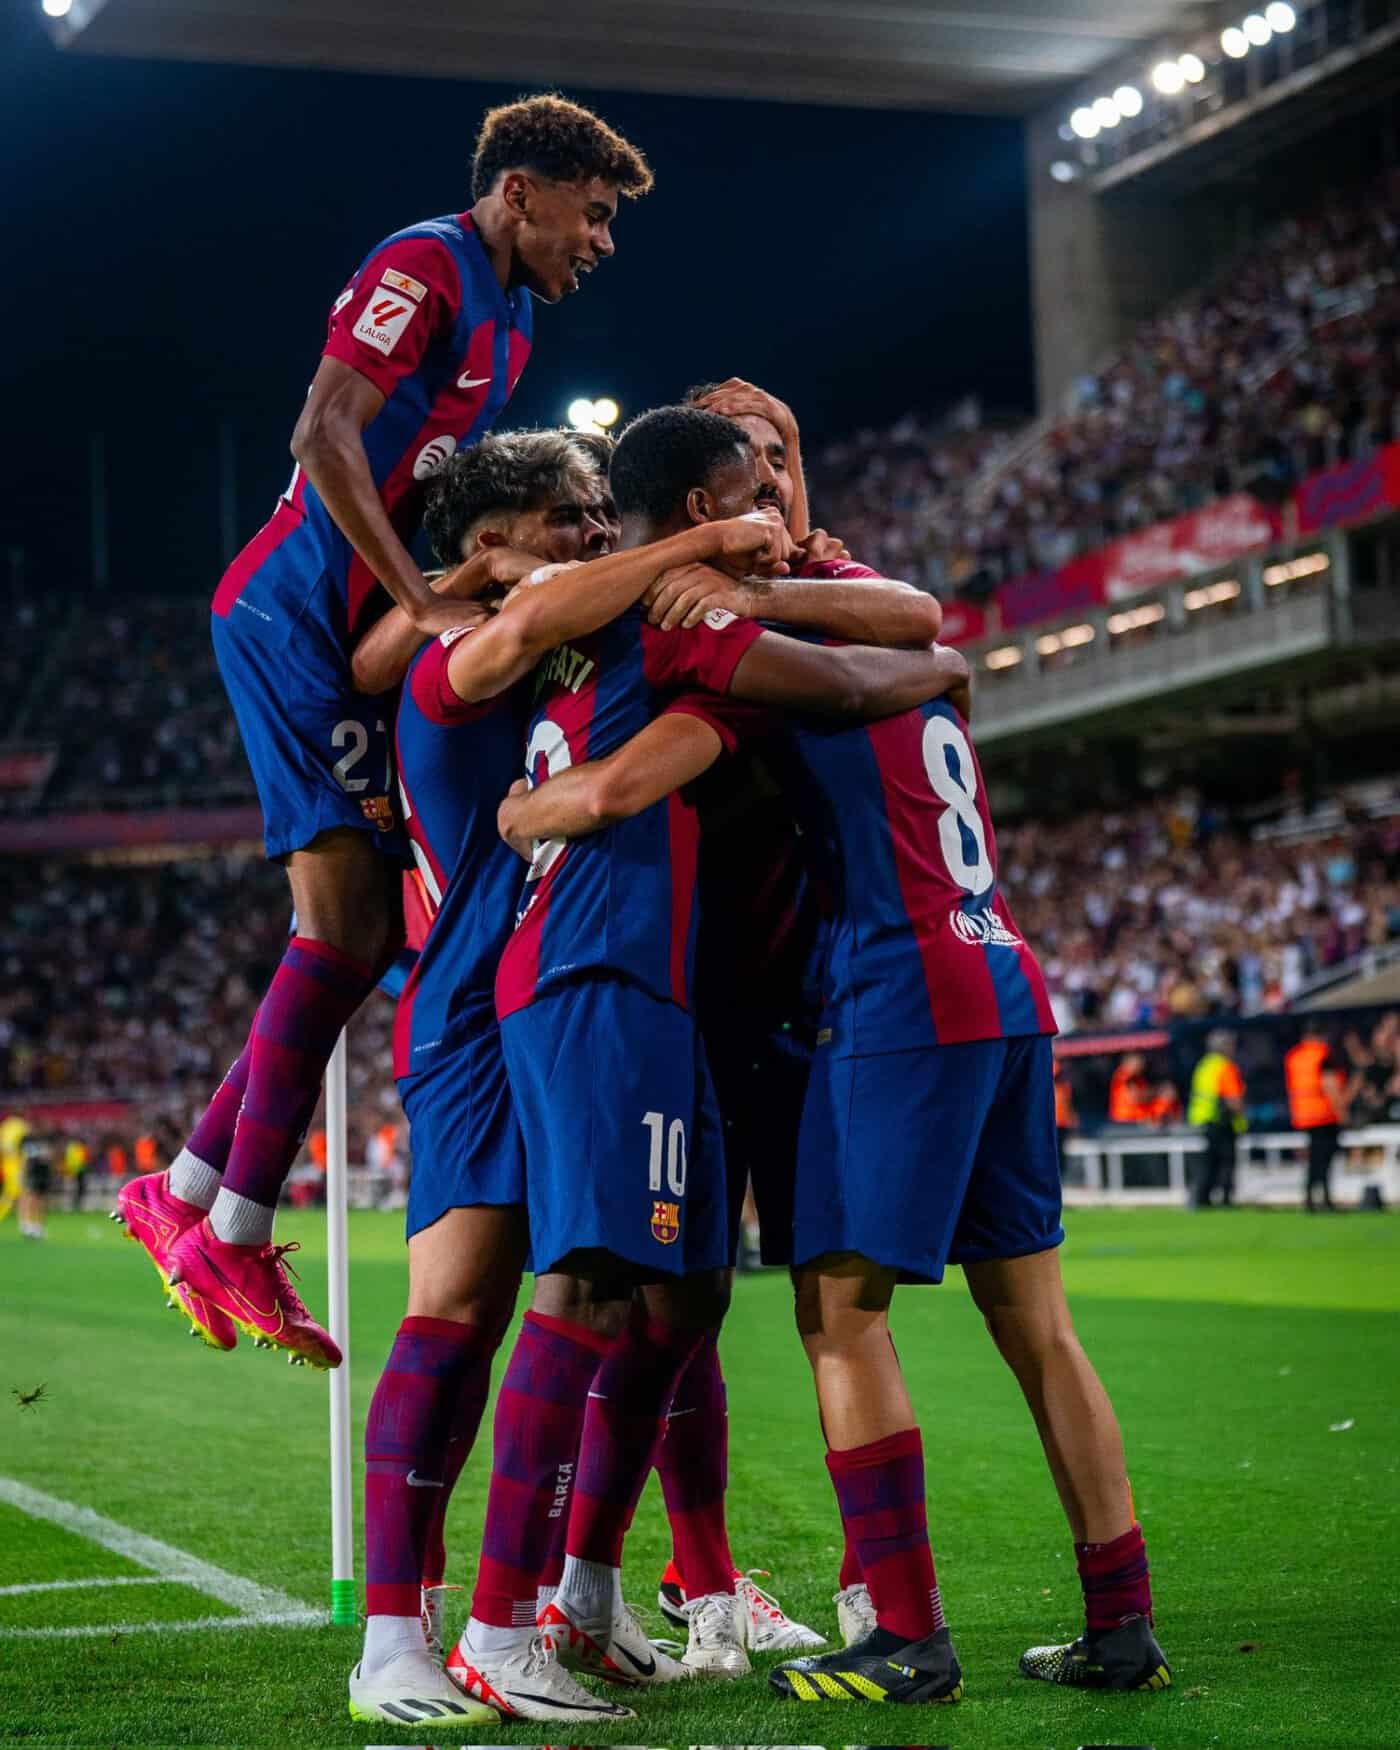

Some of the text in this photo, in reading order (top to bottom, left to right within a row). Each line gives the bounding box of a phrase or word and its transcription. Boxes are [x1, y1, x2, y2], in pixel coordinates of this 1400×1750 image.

[359, 324, 393, 346] LALIGA
[922, 715, 994, 896] 8
[641, 1111, 687, 1198] 10
